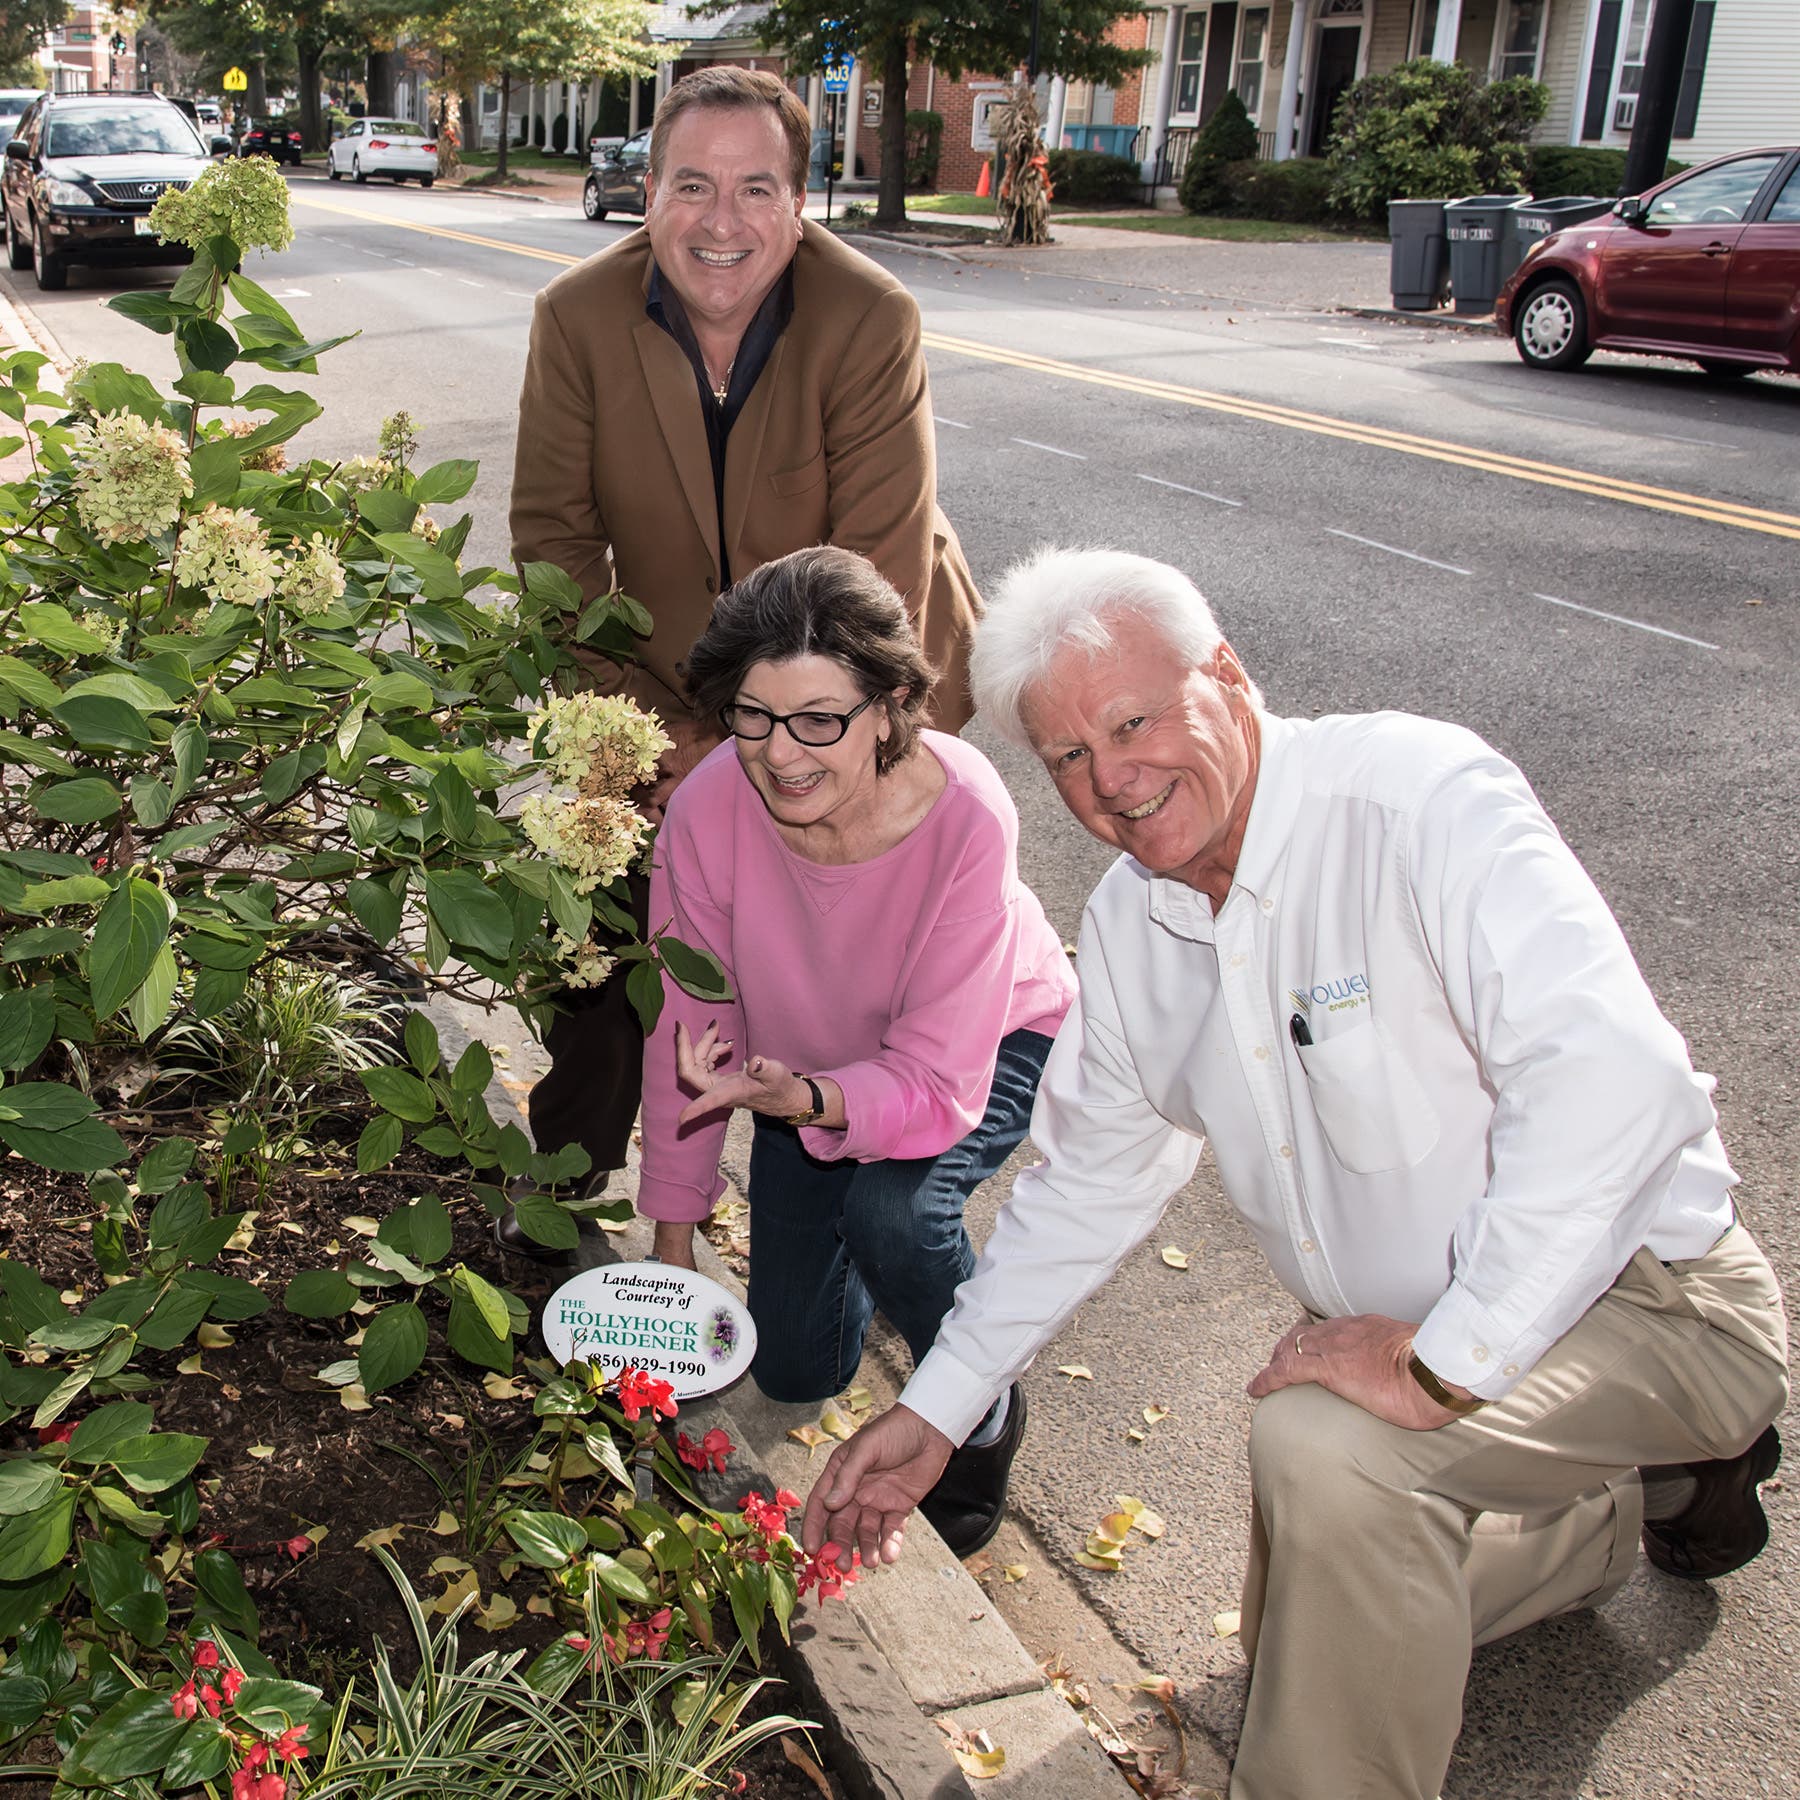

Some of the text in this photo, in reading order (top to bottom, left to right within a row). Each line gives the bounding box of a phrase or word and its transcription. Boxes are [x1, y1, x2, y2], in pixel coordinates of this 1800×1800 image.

[825, 65, 849, 82] 603
[602, 1272, 685, 1294] Landscaping
[559, 1298, 586, 1309] THE
[615, 1289, 695, 1310] Courtesy of
[559, 1309, 700, 1336] HOLLYHOCK
[573, 1327, 698, 1353] GARDENER
[630, 1356, 706, 1377] 829-1990
